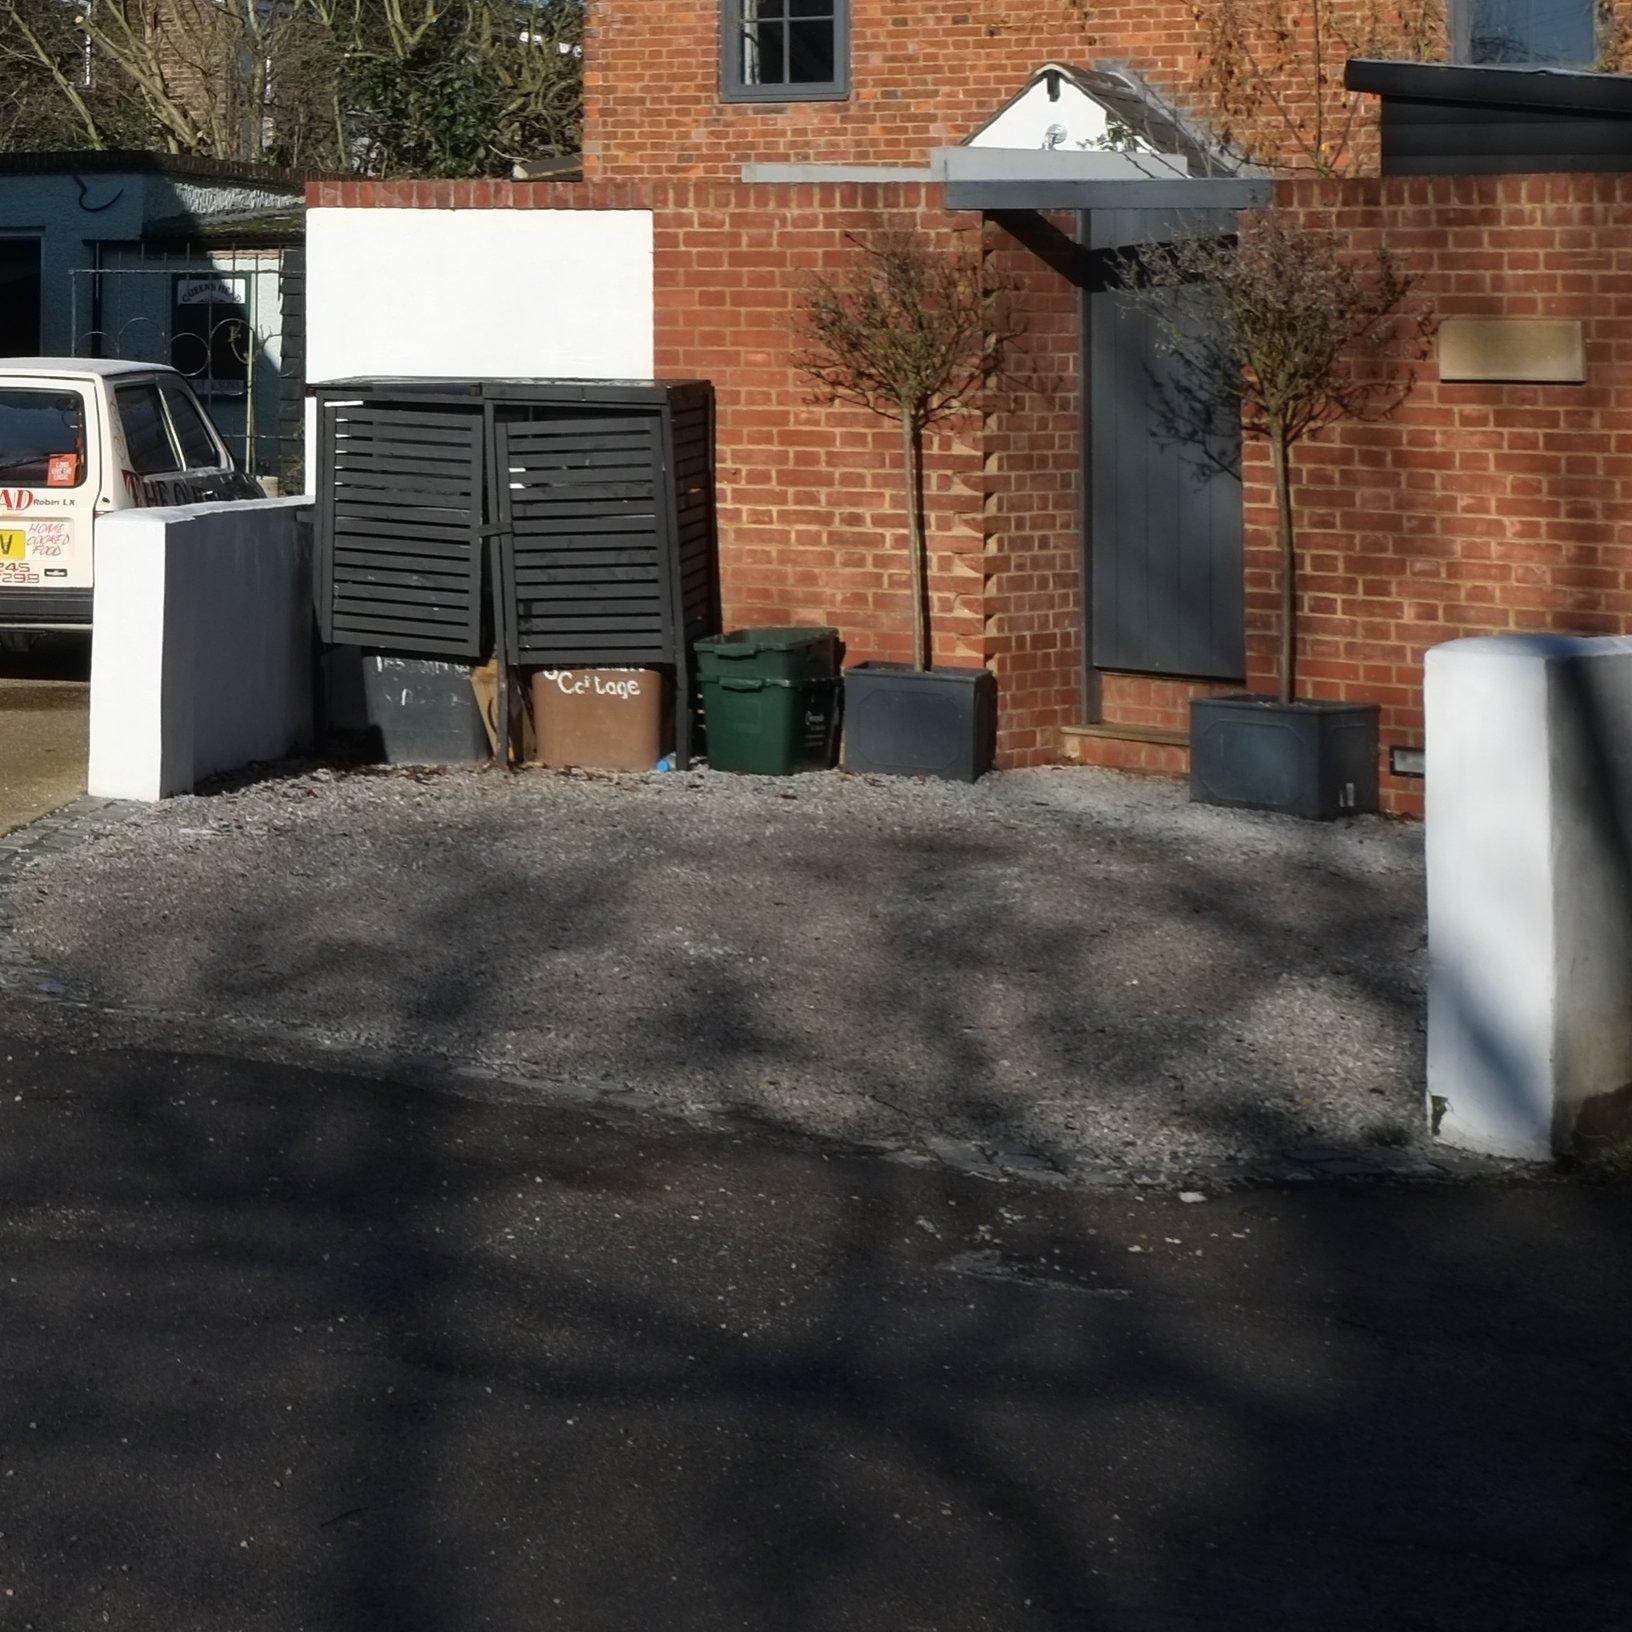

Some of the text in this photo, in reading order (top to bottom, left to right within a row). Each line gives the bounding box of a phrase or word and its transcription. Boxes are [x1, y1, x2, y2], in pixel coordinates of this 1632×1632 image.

[33, 498, 60, 506] Robin
[28, 523, 65, 534] HOME
[27, 533, 70, 546] COOKED
[32, 545, 62, 557] FOOD
